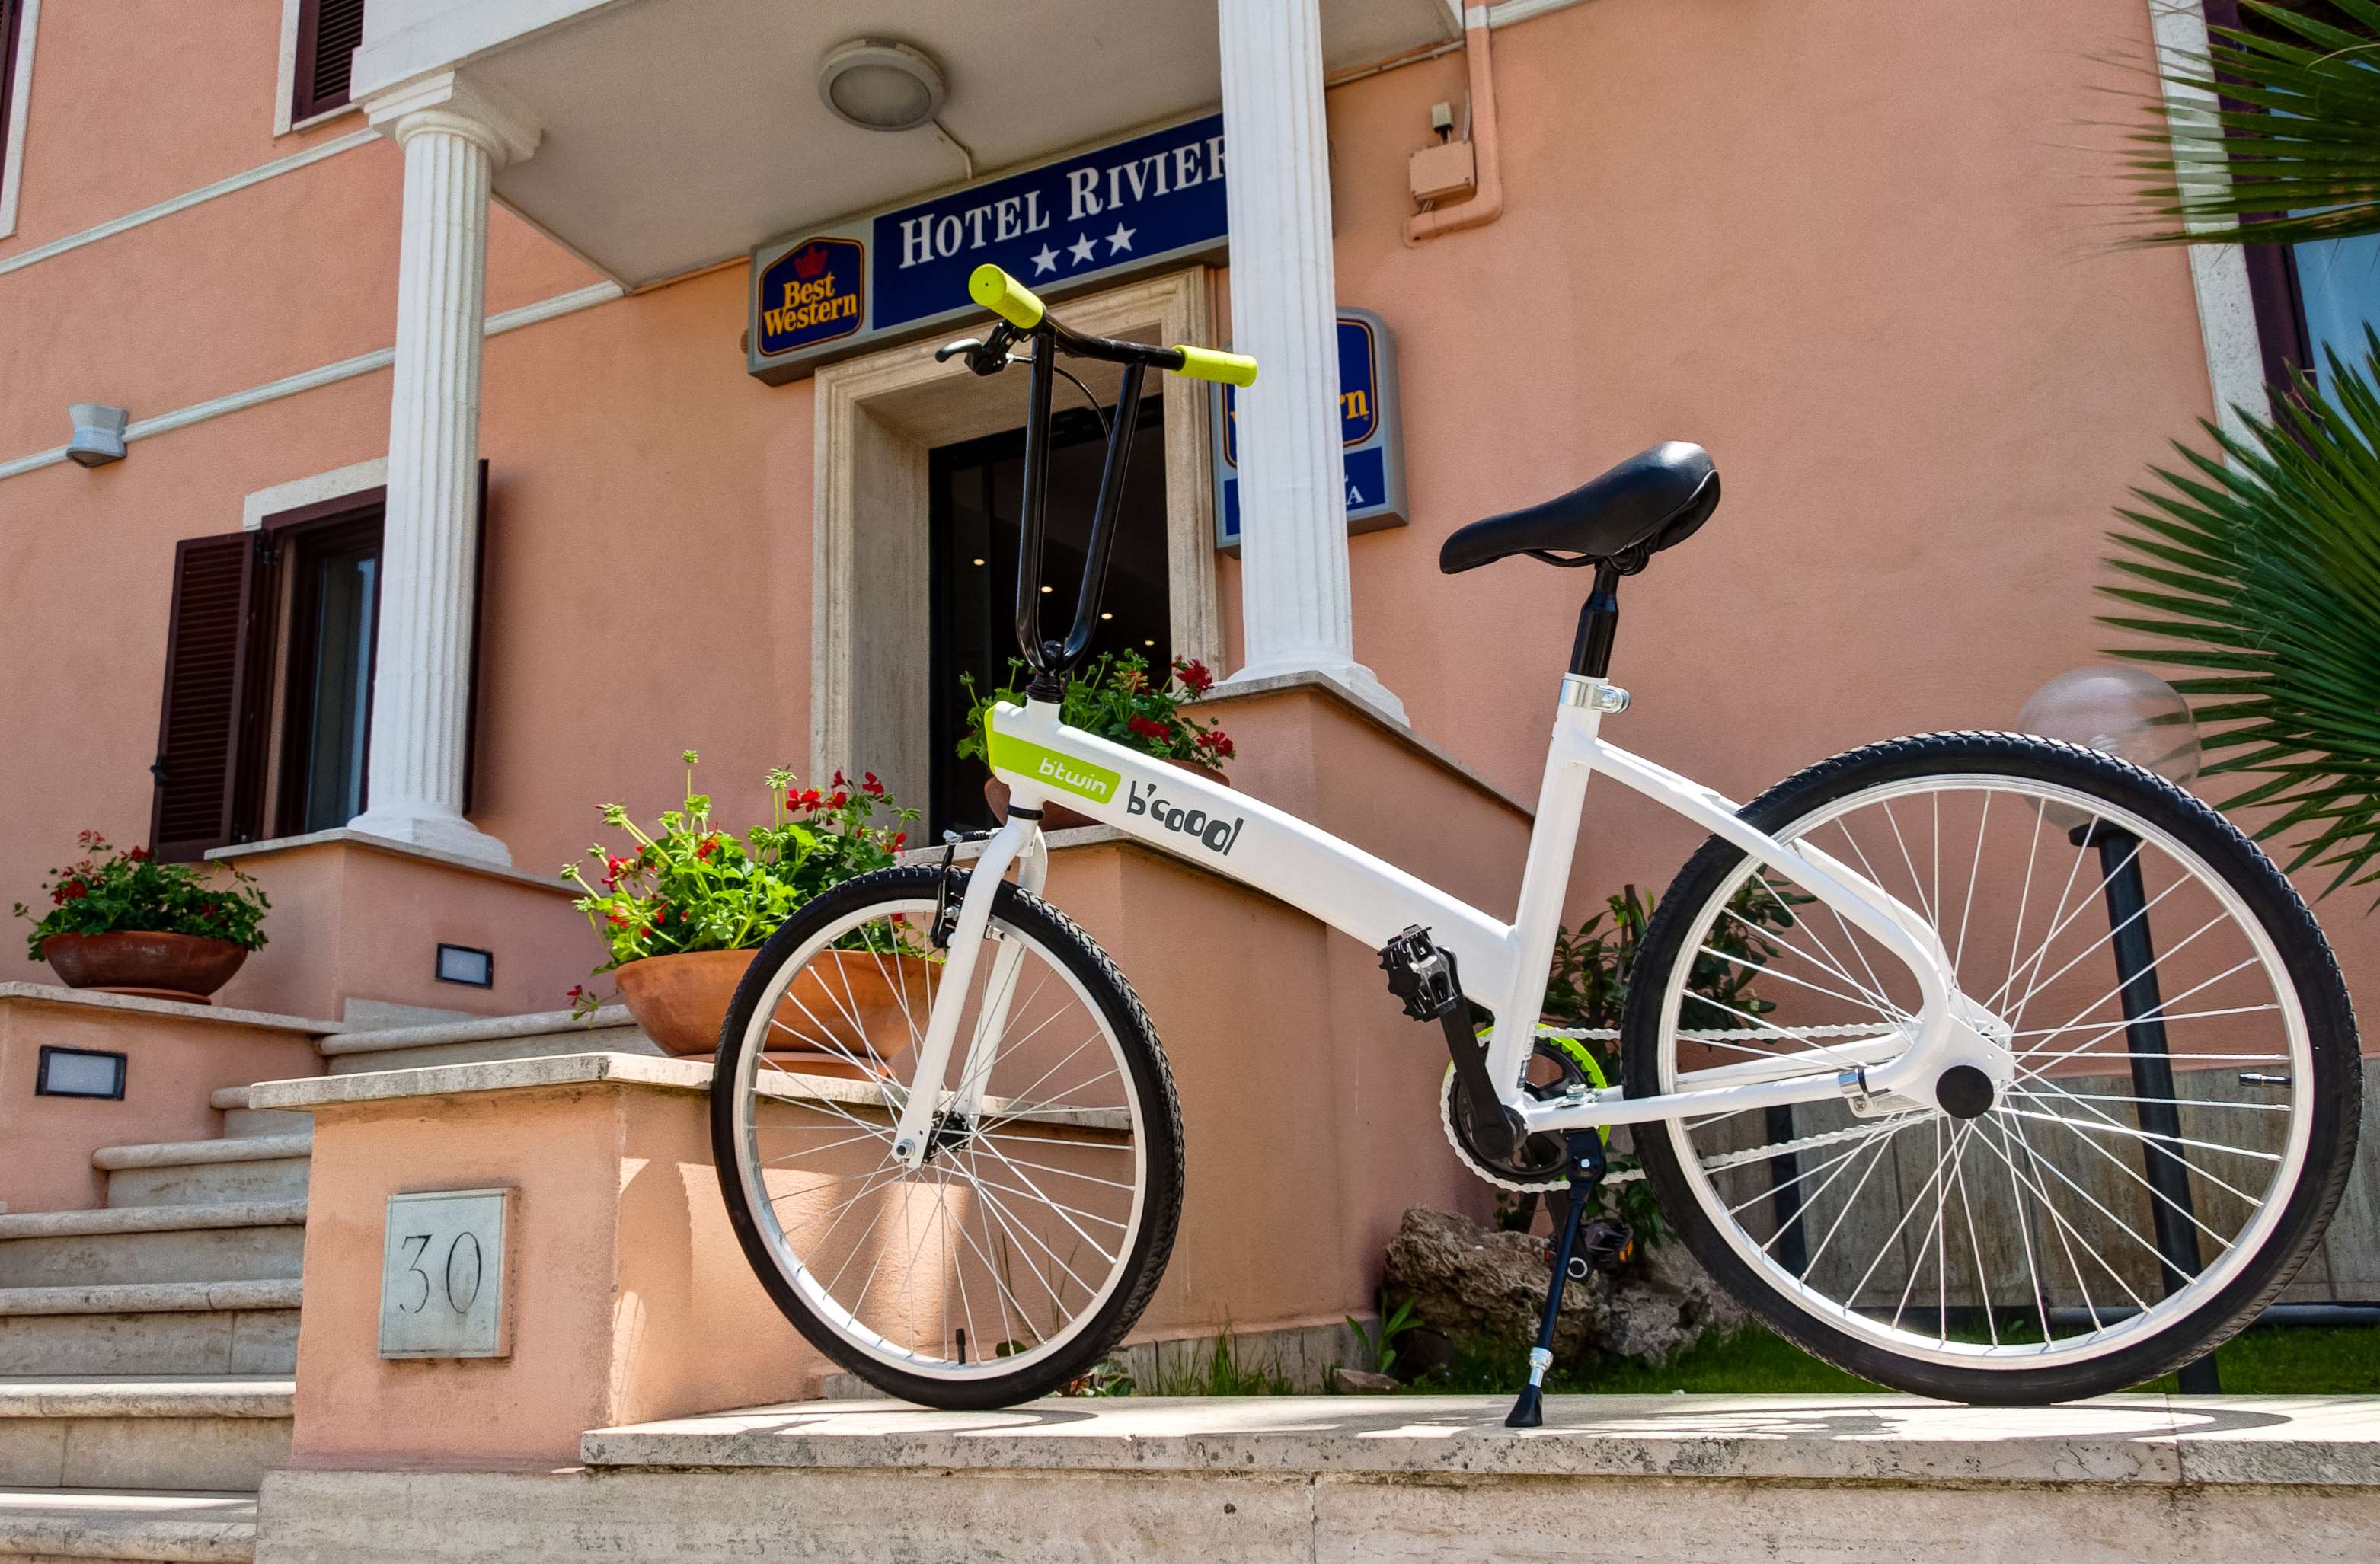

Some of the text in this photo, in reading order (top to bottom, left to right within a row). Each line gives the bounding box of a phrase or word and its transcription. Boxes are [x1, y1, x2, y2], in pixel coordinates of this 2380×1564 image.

[899, 190, 1050, 270] HOTEL
[763, 293, 858, 337] Western
[783, 270, 835, 308] Best
[399, 1231, 482, 1314] 30
